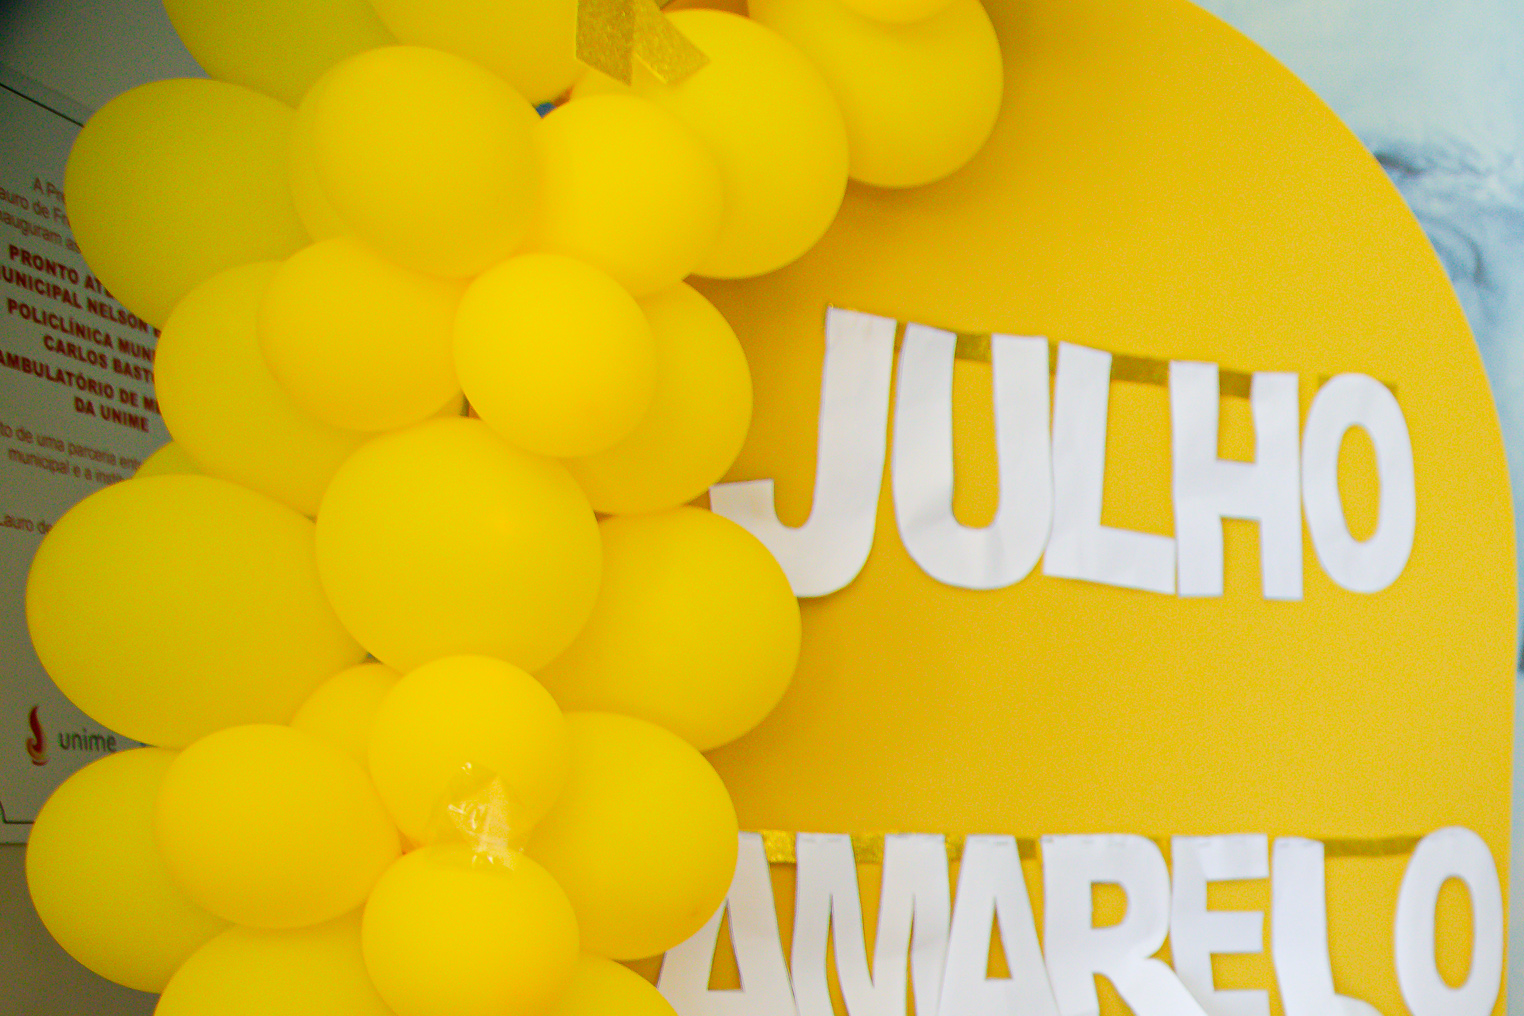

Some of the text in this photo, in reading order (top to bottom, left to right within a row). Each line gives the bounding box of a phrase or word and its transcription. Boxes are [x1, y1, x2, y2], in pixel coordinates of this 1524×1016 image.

[9, 244, 79, 285] PRONTO
[0, 265, 82, 310] UNICIPAL
[87, 297, 149, 333] NELSON
[7, 297, 113, 350] POLICLÍNICA
[43, 334, 108, 369] CARLOS
[74, 396, 95, 416] DA
[100, 404, 149, 433] UNIME
[119, 387, 139, 407] DE
[709, 304, 1416, 600] JULHO
[58, 731, 117, 753] unime
